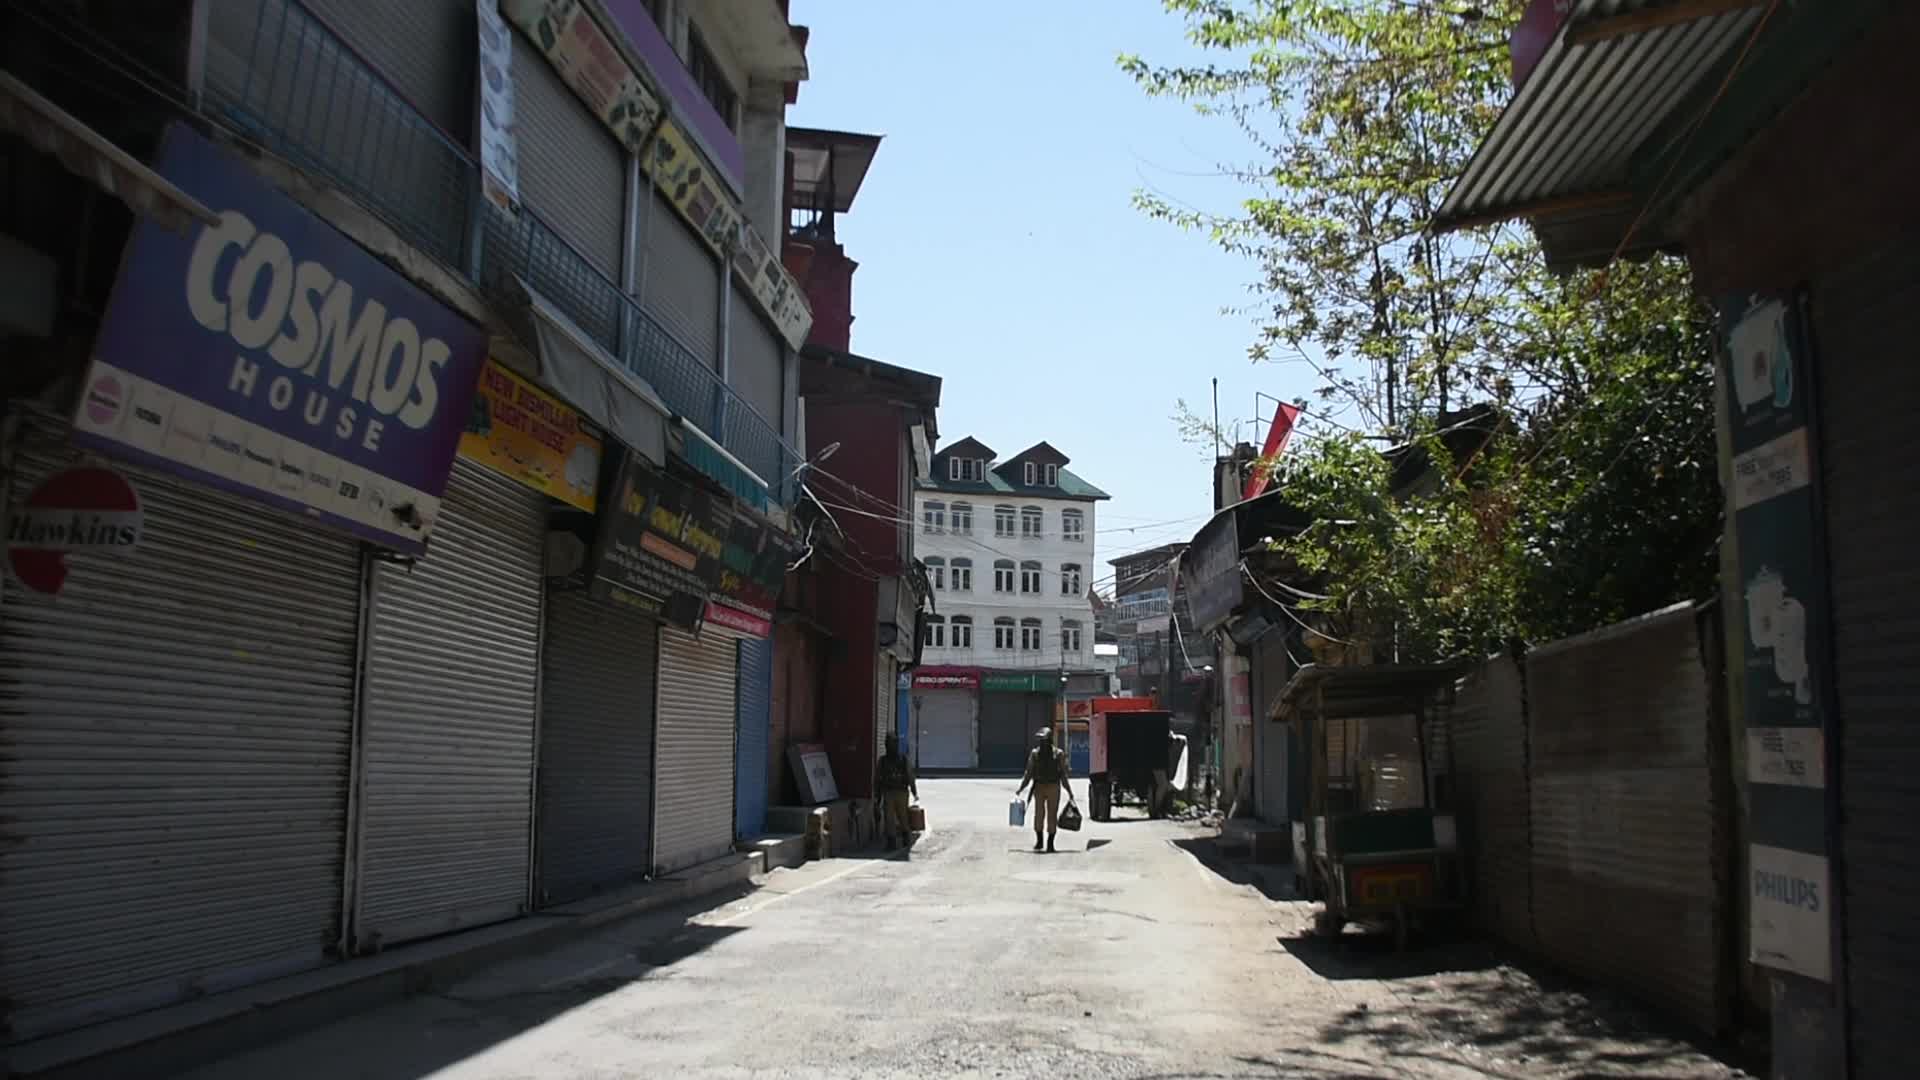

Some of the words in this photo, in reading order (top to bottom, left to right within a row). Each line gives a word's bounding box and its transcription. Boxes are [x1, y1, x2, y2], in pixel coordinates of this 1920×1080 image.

[186, 209, 452, 430] COSMOS
[227, 355, 384, 454] HOUSE
[1754, 869, 1820, 913] PHILIPS
